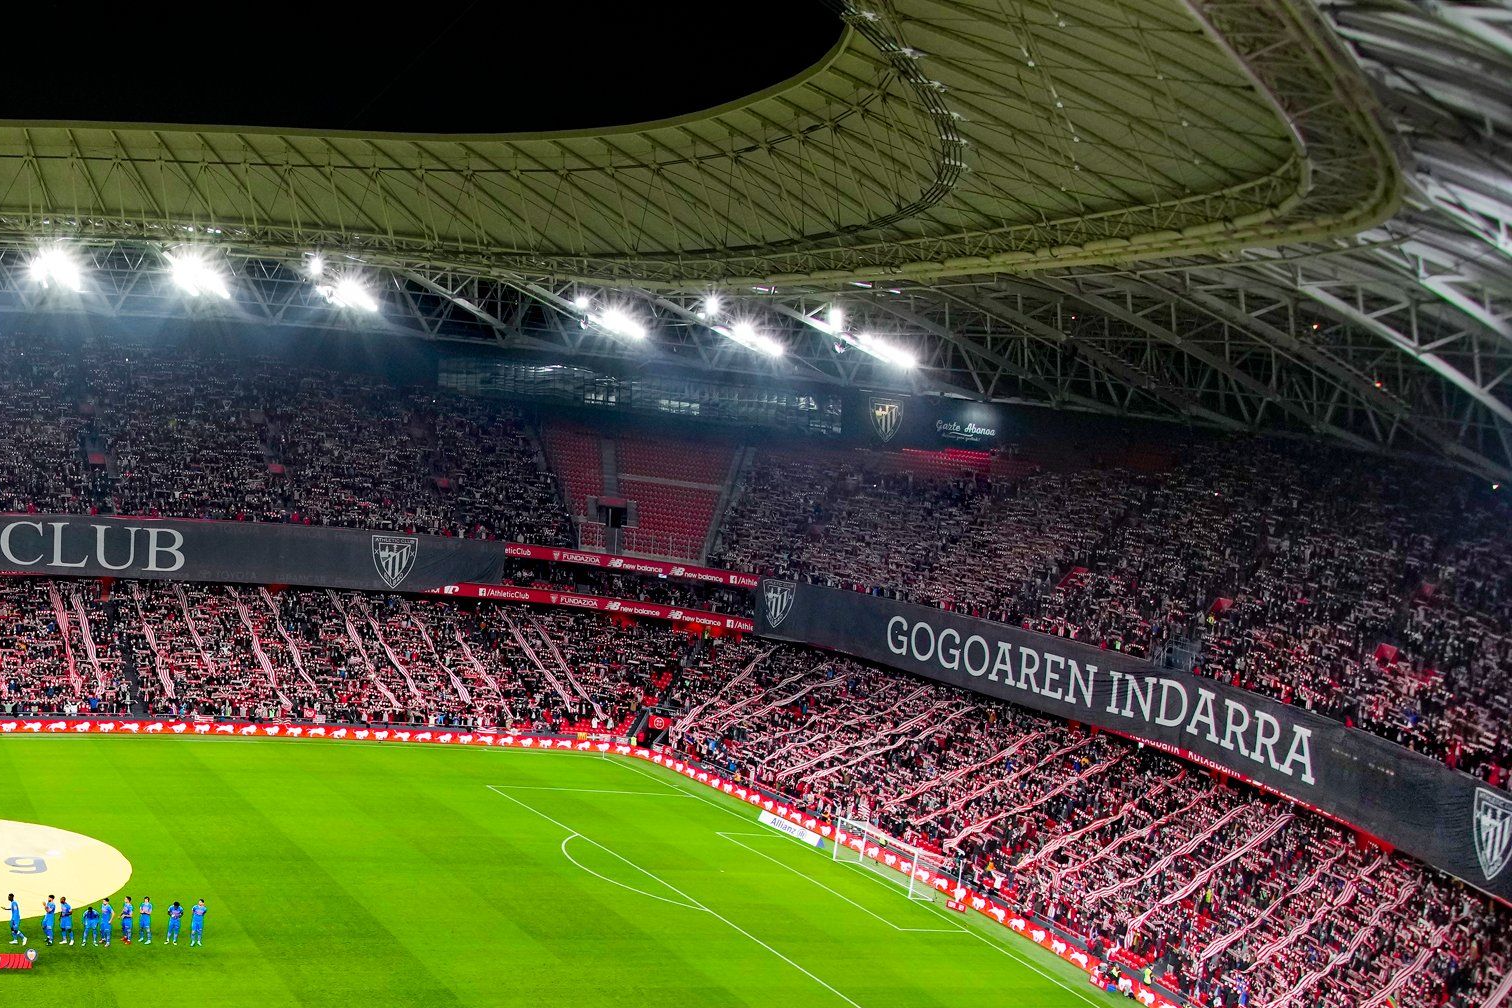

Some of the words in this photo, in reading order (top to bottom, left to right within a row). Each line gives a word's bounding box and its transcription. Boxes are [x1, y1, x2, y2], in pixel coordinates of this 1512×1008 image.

[935, 419, 961, 432] Gazte
[0, 521, 185, 572] CLUB
[562, 553, 601, 564] FUNDAZIOA
[622, 563, 637, 571] new
[637, 563, 663, 574] balance
[684, 571, 698, 579] new
[698, 572, 724, 583] balance
[560, 597, 598, 607] FUNDAZIOA
[620, 606, 634, 614] new
[634, 606, 661, 617] balance
[682, 615, 696, 623] new
[696, 616, 722, 627] balance
[887, 615, 1098, 708] GOGOAREN
[1105, 670, 1317, 785] INDARRA
[770, 817, 797, 834] Allianz
